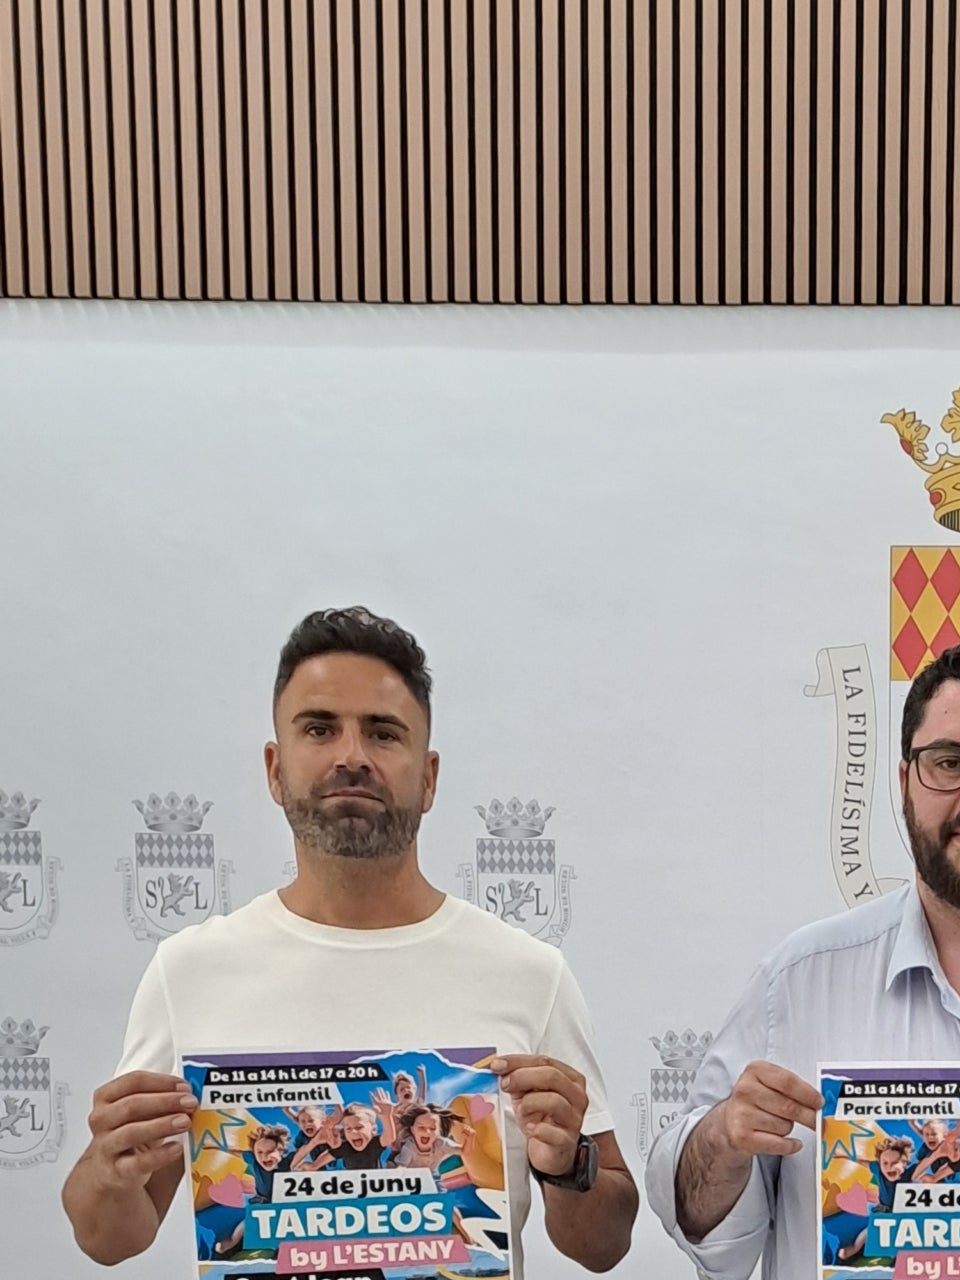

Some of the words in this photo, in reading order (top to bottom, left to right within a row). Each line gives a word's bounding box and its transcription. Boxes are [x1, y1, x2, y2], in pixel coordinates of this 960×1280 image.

[842, 665, 864, 701] LA
[840, 712, 867, 876] FIDELÍSIMA
[853, 882, 874, 900] Y
[210, 1071, 229, 1082] De
[232, 1070, 244, 1082] 11
[248, 1072, 258, 1081] a
[260, 1069, 276, 1081] 14
[278, 1069, 289, 1080] h
[299, 1068, 318, 1080] de
[319, 1067, 333, 1079] 17
[336, 1070, 346, 1079] a
[350, 1067, 366, 1078] 20
[368, 1067, 378, 1078] h
[210, 1090, 253, 1104] Parc
[257, 1087, 332, 1102] infantil
[844, 1084, 862, 1095] De
[864, 1084, 876, 1094] 11
[879, 1086, 888, 1094] a
[890, 1084, 904, 1094] 14
[906, 1084, 916, 1094] h
[925, 1084, 942, 1094] de
[944, 1083, 957, 1094] 17
[843, 1103, 882, 1115] Parc
[885, 1101, 954, 1115] infantil
[284, 1177, 314, 1197] 24
[321, 1176, 354, 1195] de
[357, 1173, 421, 1198] juny
[904, 1189, 933, 1207] 24
[251, 1201, 447, 1239] TARDEOS
[290, 1247, 328, 1271] by
[906, 1257, 941, 1280] by
